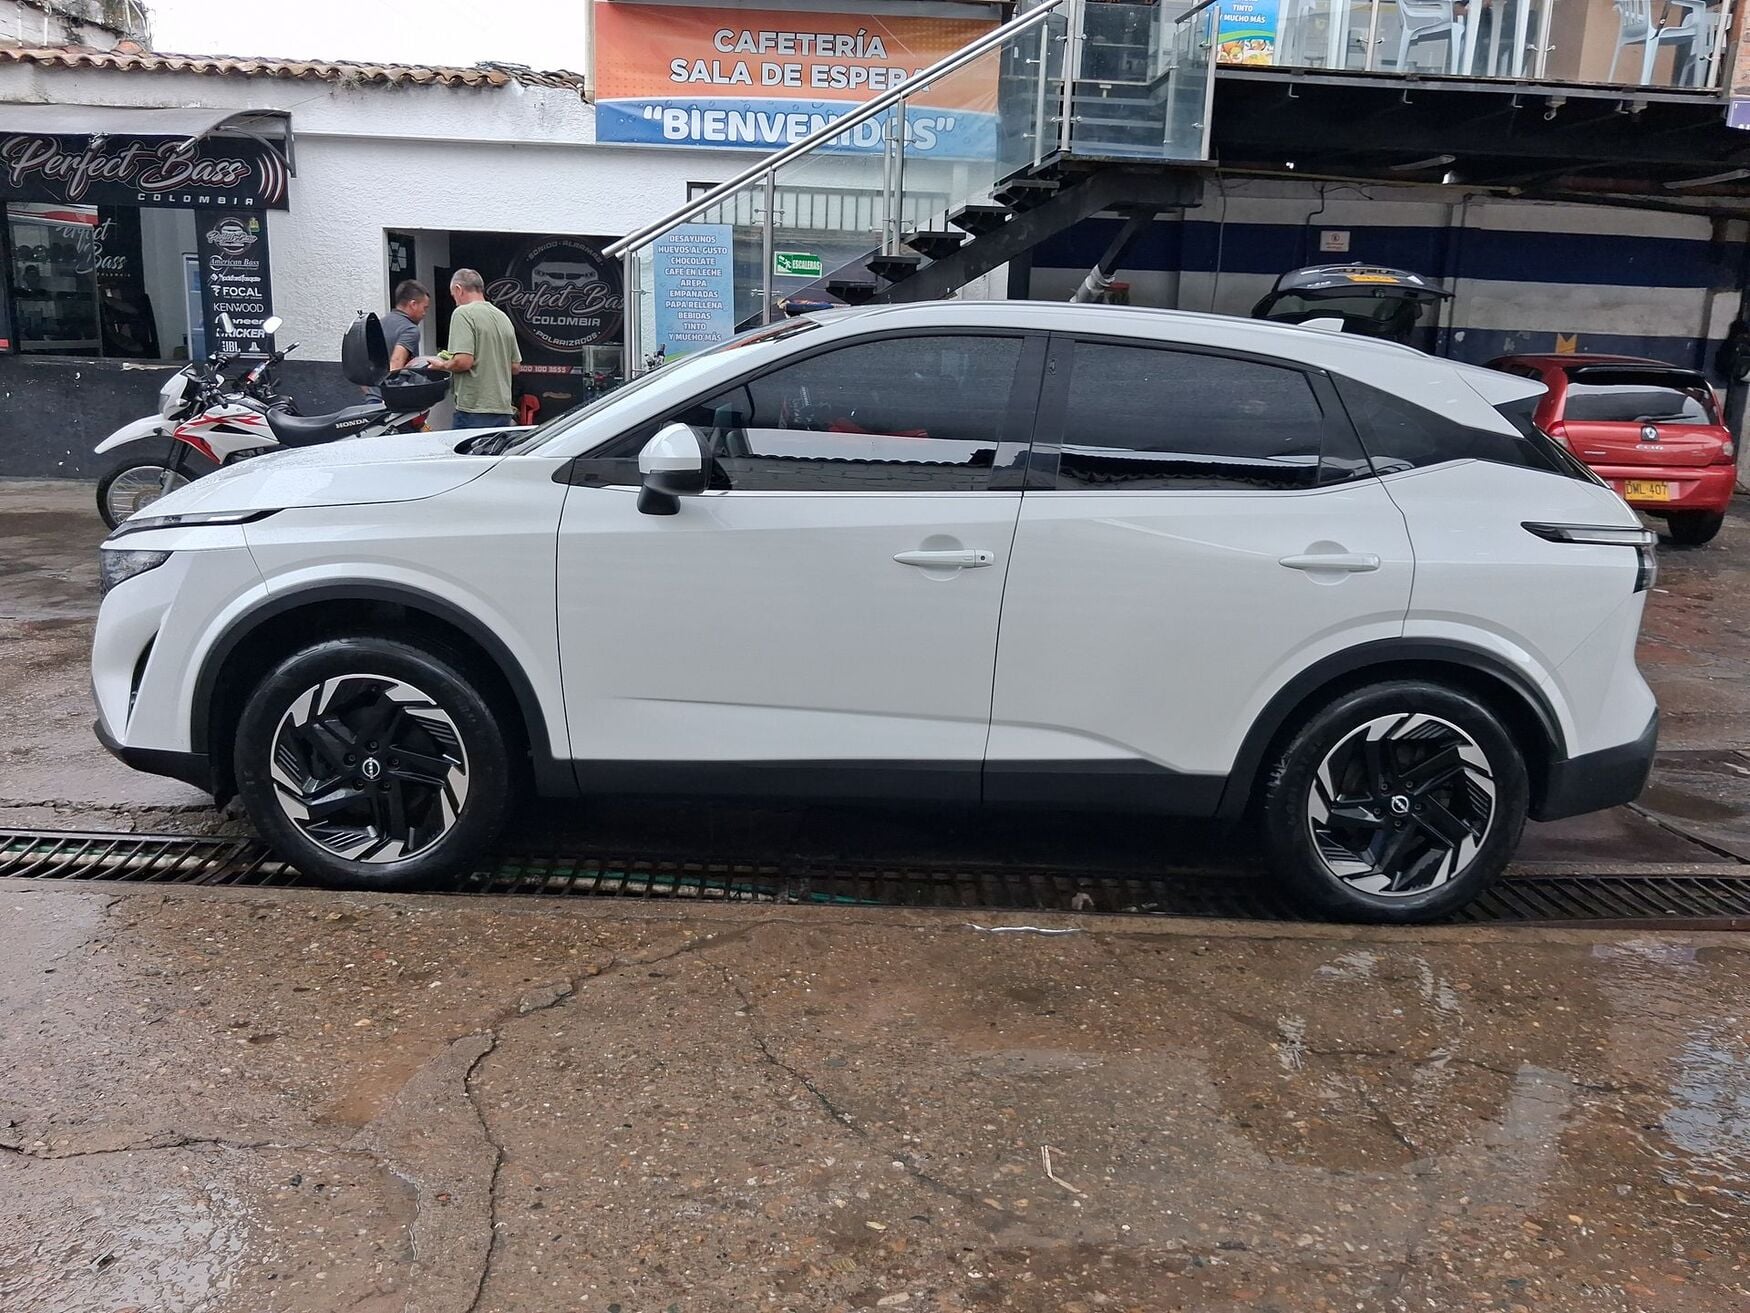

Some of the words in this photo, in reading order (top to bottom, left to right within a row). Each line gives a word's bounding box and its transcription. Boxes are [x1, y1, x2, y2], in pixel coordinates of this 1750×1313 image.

[1232, 4, 1254, 12] TINTO
[1223, 14, 1249, 22] MUCHO
[1249, 14, 1266, 24] MÁS
[713, 28, 887, 59] CAFETERÍA
[669, 57, 753, 85] SALA
[761, 61, 802, 88] DE
[2, 136, 157, 198] Perfect
[138, 141, 243, 189] Bass
[137, 193, 254, 206] COLOMBIA
[669, 235, 717, 243] DESAYUNOS
[657, 246, 690, 254] HUEVOS
[691, 246, 701, 254] AL
[702, 247, 728, 255] GUSTO
[670, 257, 717, 265] CHOCOLATE
[664, 268, 685, 276] CAFE
[685, 268, 696, 276] EN
[697, 268, 723, 277] LECHE
[680, 279, 708, 288] AREPA
[222, 286, 262, 297] FOCAL
[669, 290, 719, 298] EMPANADAS
[486, 278, 581, 319] Perfect
[213, 302, 264, 313] KENWOOD
[665, 300, 687, 308] PAPA
[688, 301, 723, 309] RELLENA
[678, 311, 712, 320] BEBIDAS
[532, 316, 601, 327] COLOMBIA
[535, 330, 598, 347] POLARIZADOS
[675, 333, 704, 341] MUCHO
[704, 332, 721, 341] MÁS
[335, 418, 369, 429] HONDA
[1649, 484, 1668, 496] 407
